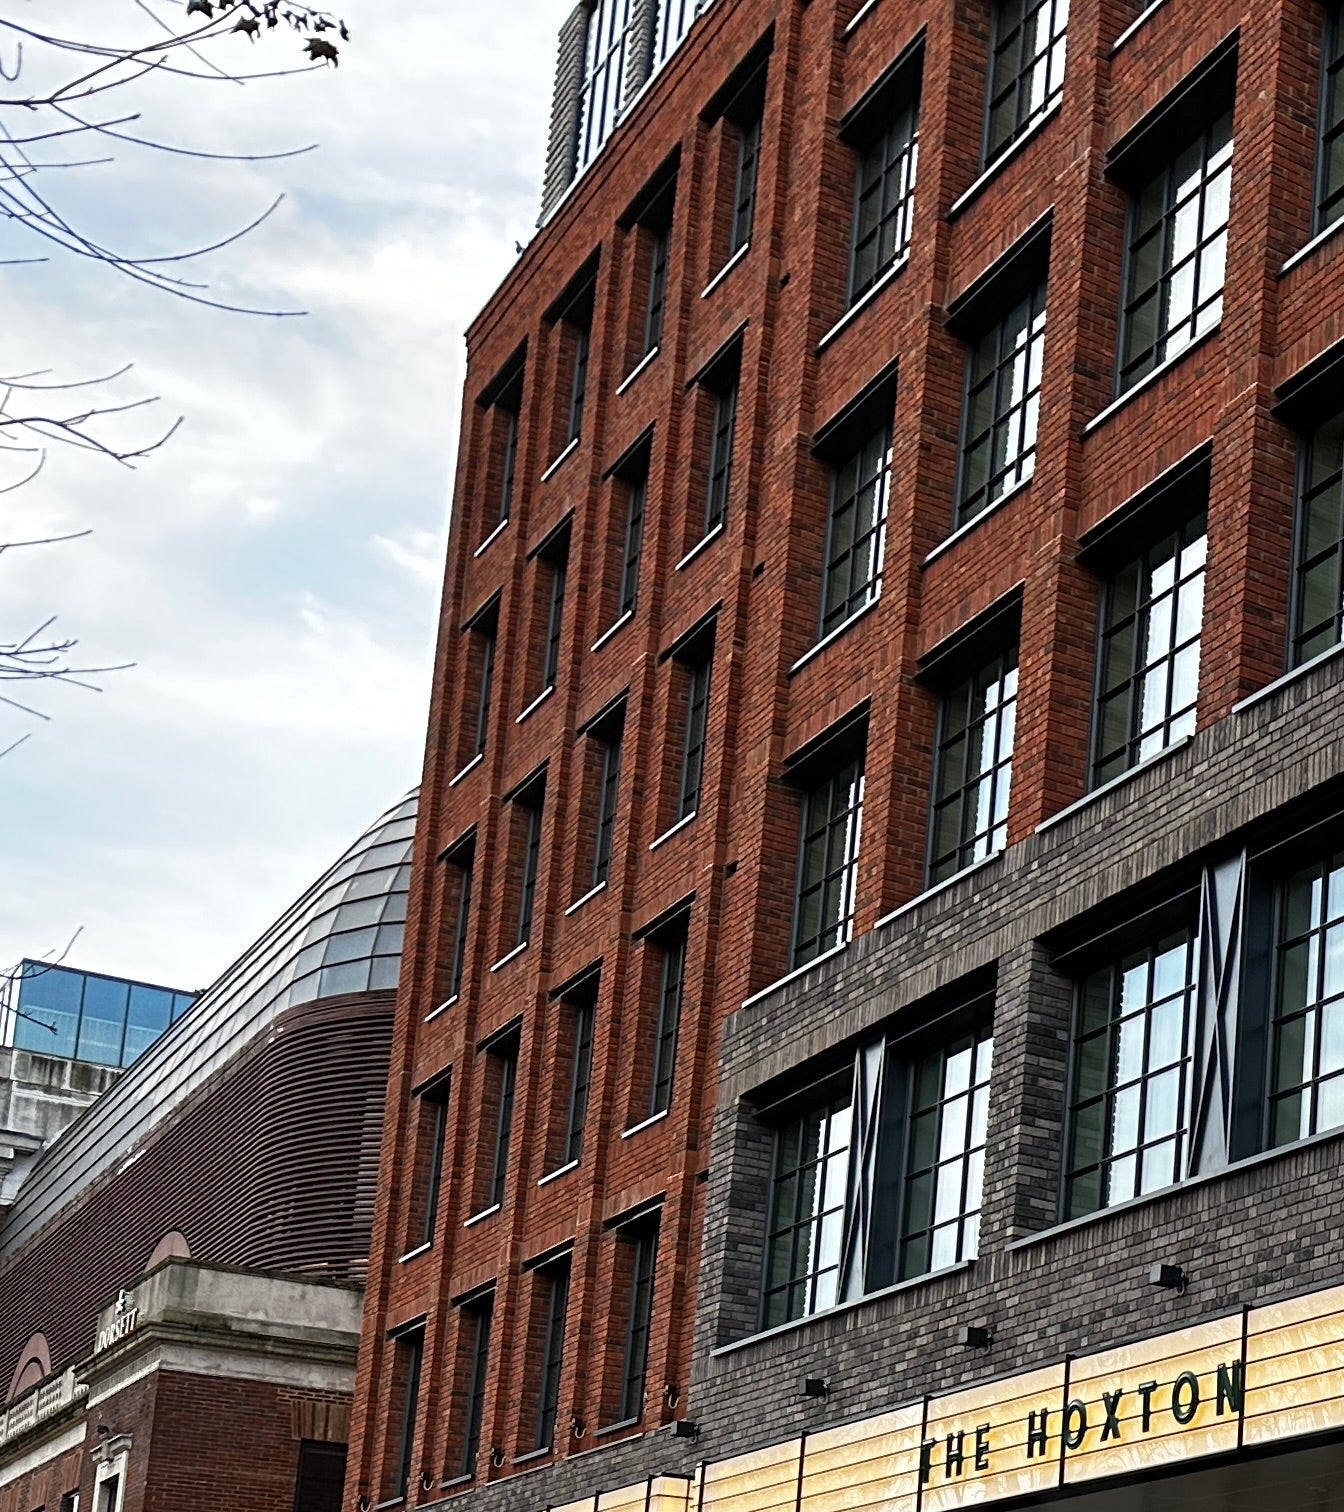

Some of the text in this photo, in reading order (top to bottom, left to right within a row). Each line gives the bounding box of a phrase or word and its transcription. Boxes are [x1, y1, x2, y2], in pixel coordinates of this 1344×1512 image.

[96, 1307, 138, 1353] DORSETT
[921, 1359, 1242, 1484] THE HOXTON
